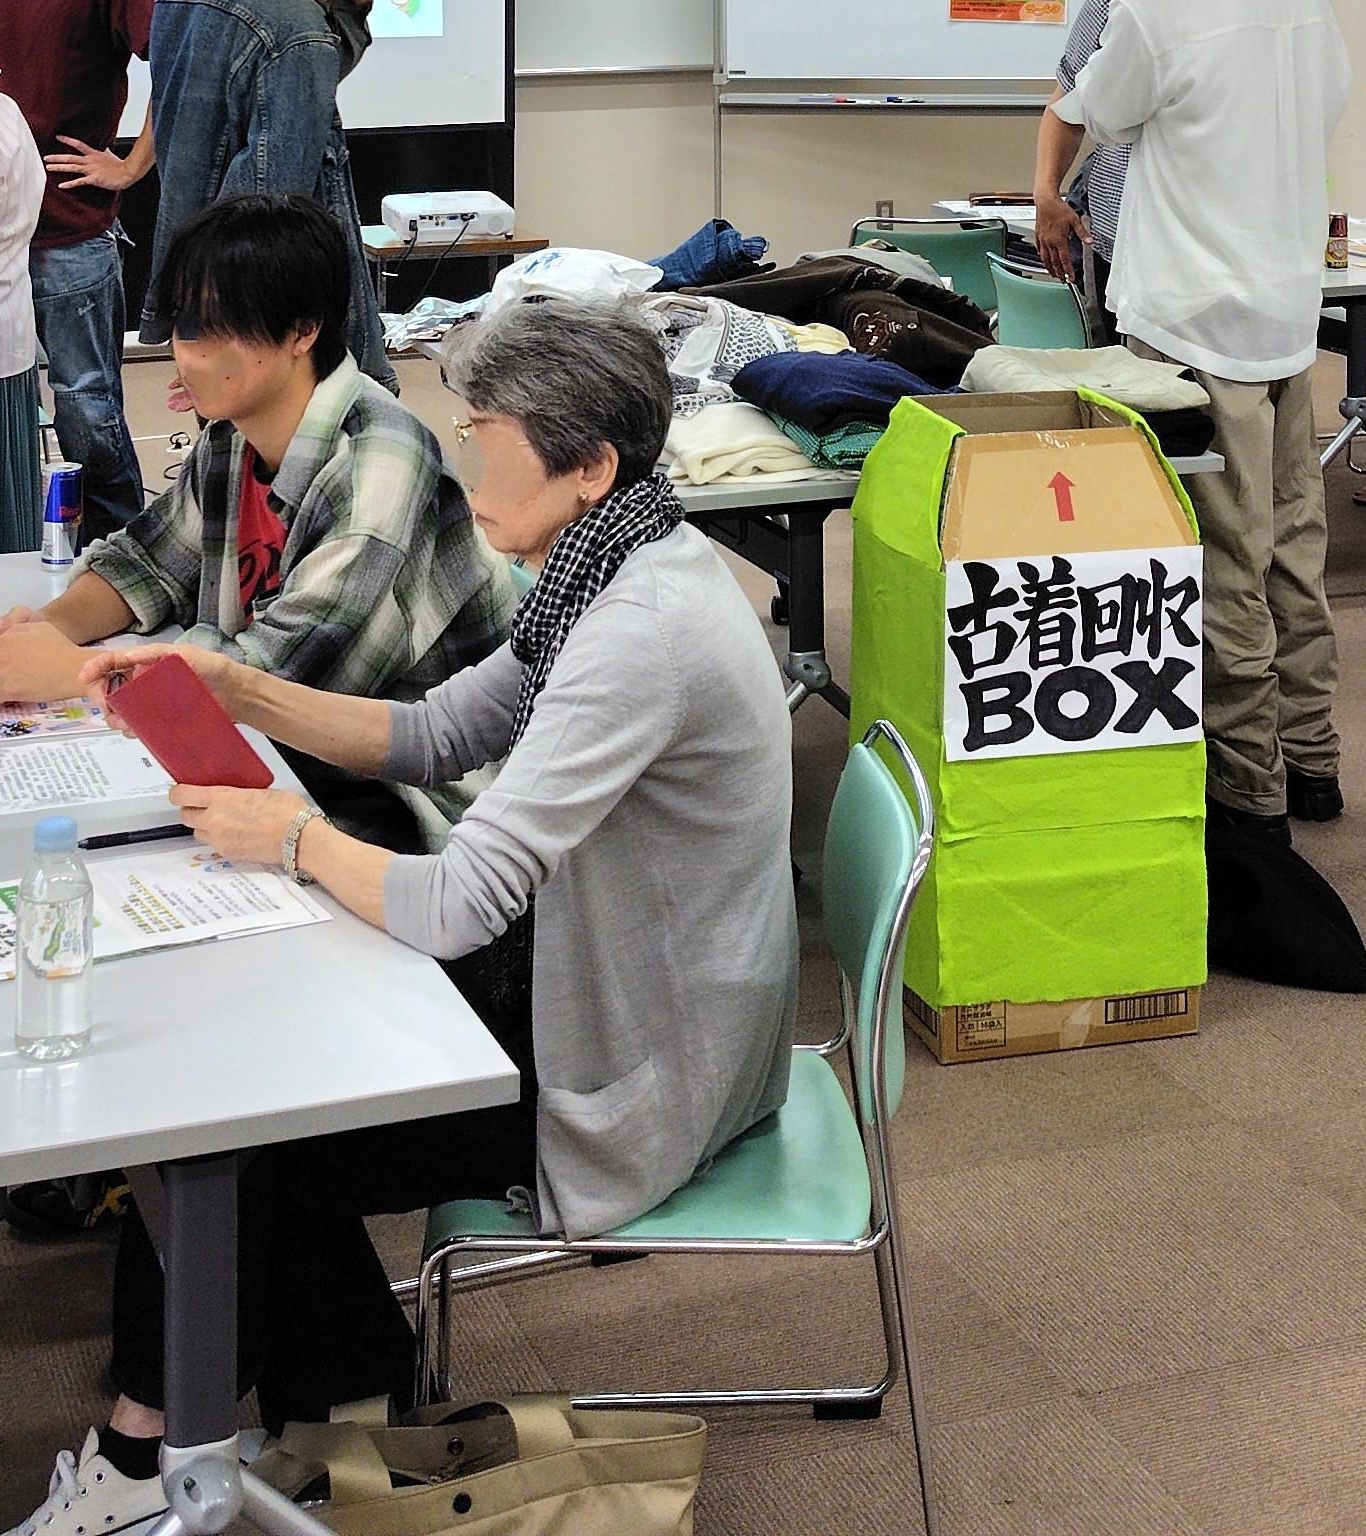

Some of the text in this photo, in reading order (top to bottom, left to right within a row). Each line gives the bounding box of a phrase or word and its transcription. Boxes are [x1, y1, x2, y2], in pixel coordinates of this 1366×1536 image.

[947, 555, 1201, 680] 古着回収
[959, 657, 1200, 752] BOX
